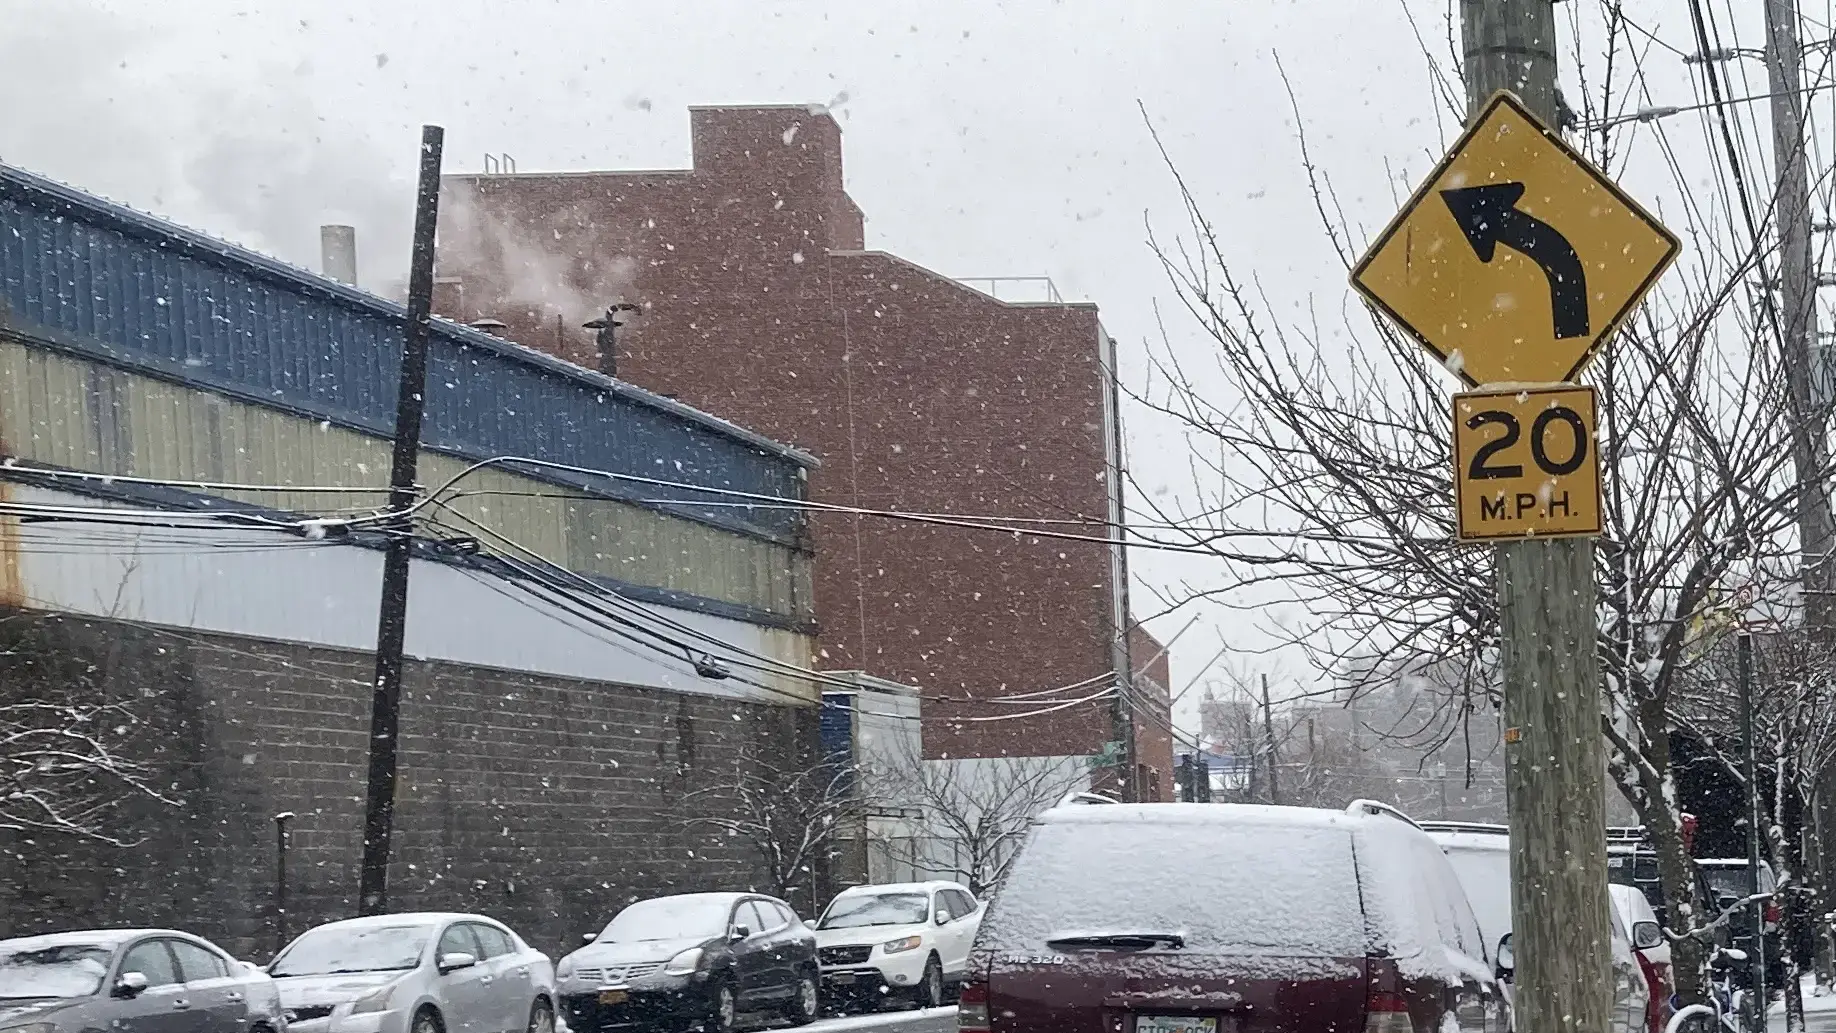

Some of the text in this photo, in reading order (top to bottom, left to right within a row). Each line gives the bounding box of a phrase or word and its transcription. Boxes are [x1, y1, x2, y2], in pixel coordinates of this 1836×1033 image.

[1464, 406, 1588, 480] 20
[1480, 491, 1579, 522] M.P.H.
[1031, 955, 1065, 965] 320
